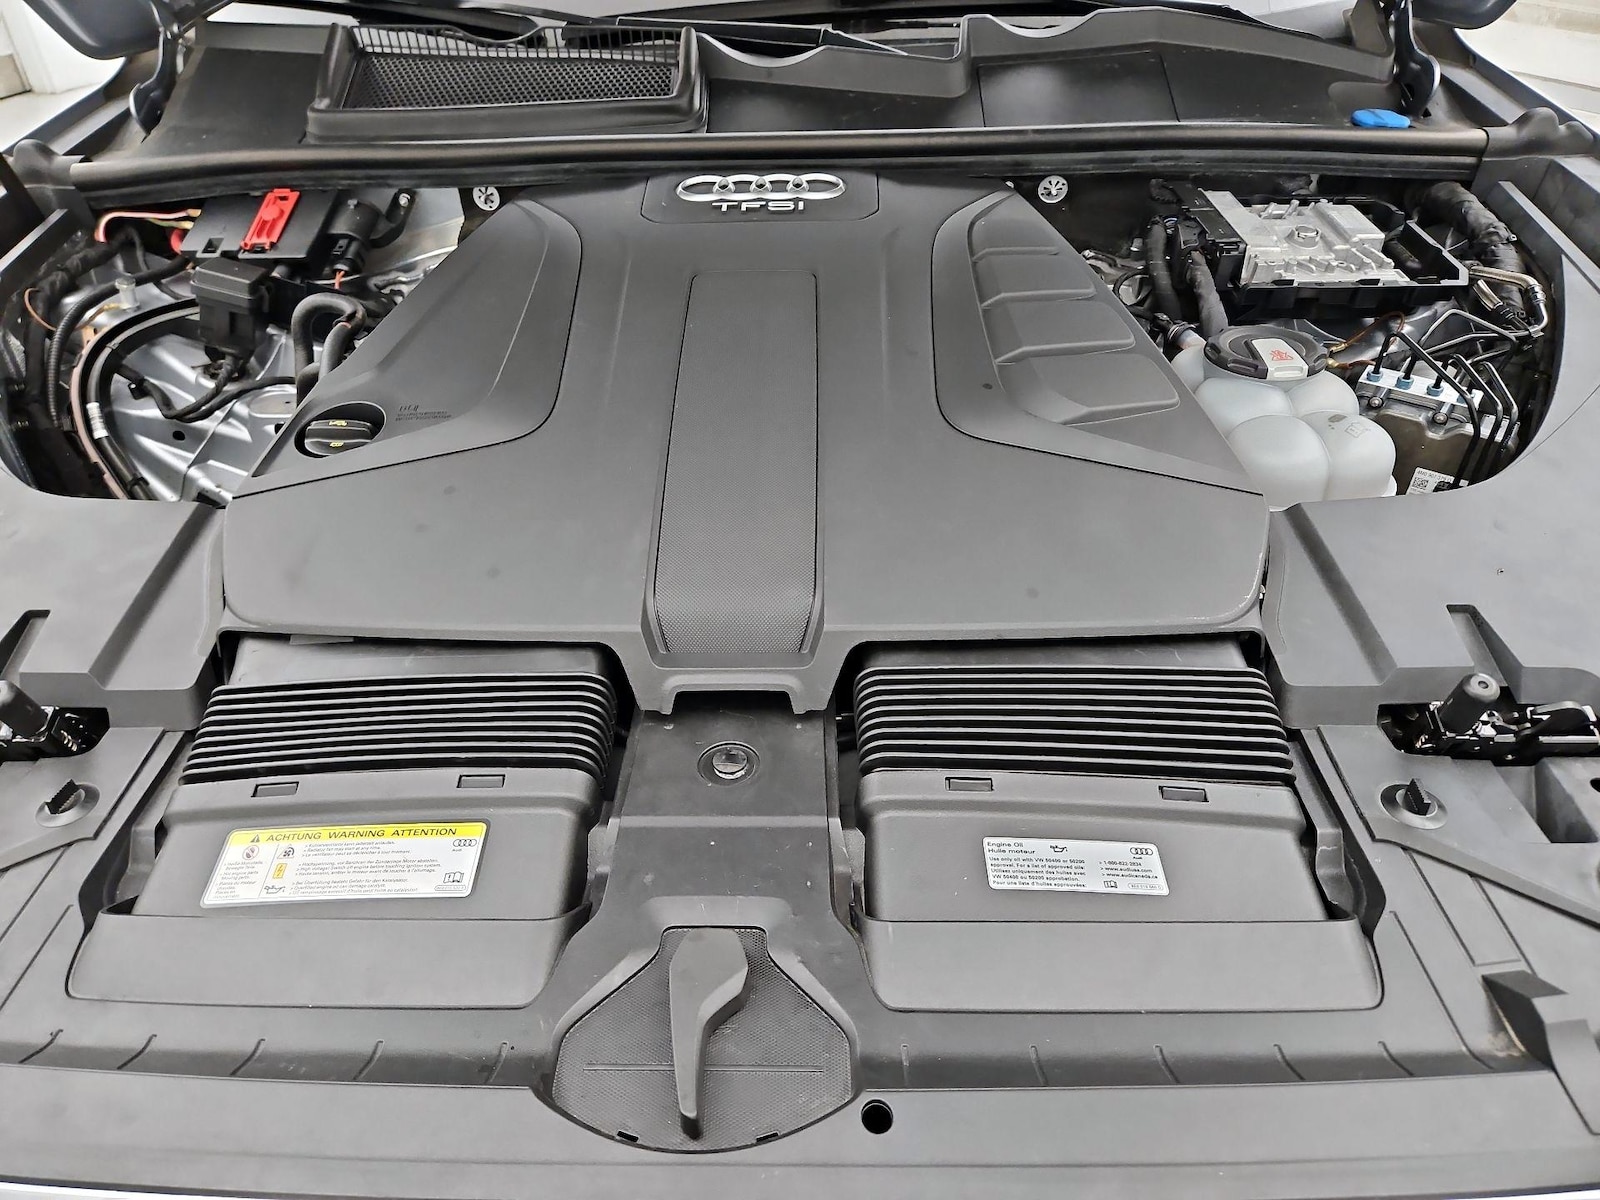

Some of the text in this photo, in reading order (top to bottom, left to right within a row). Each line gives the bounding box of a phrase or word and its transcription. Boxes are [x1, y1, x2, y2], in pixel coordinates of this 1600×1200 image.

[712, 200, 805, 213] TFSI
[266, 828, 458, 842] ACHTUNG WARNING ATTENTION
